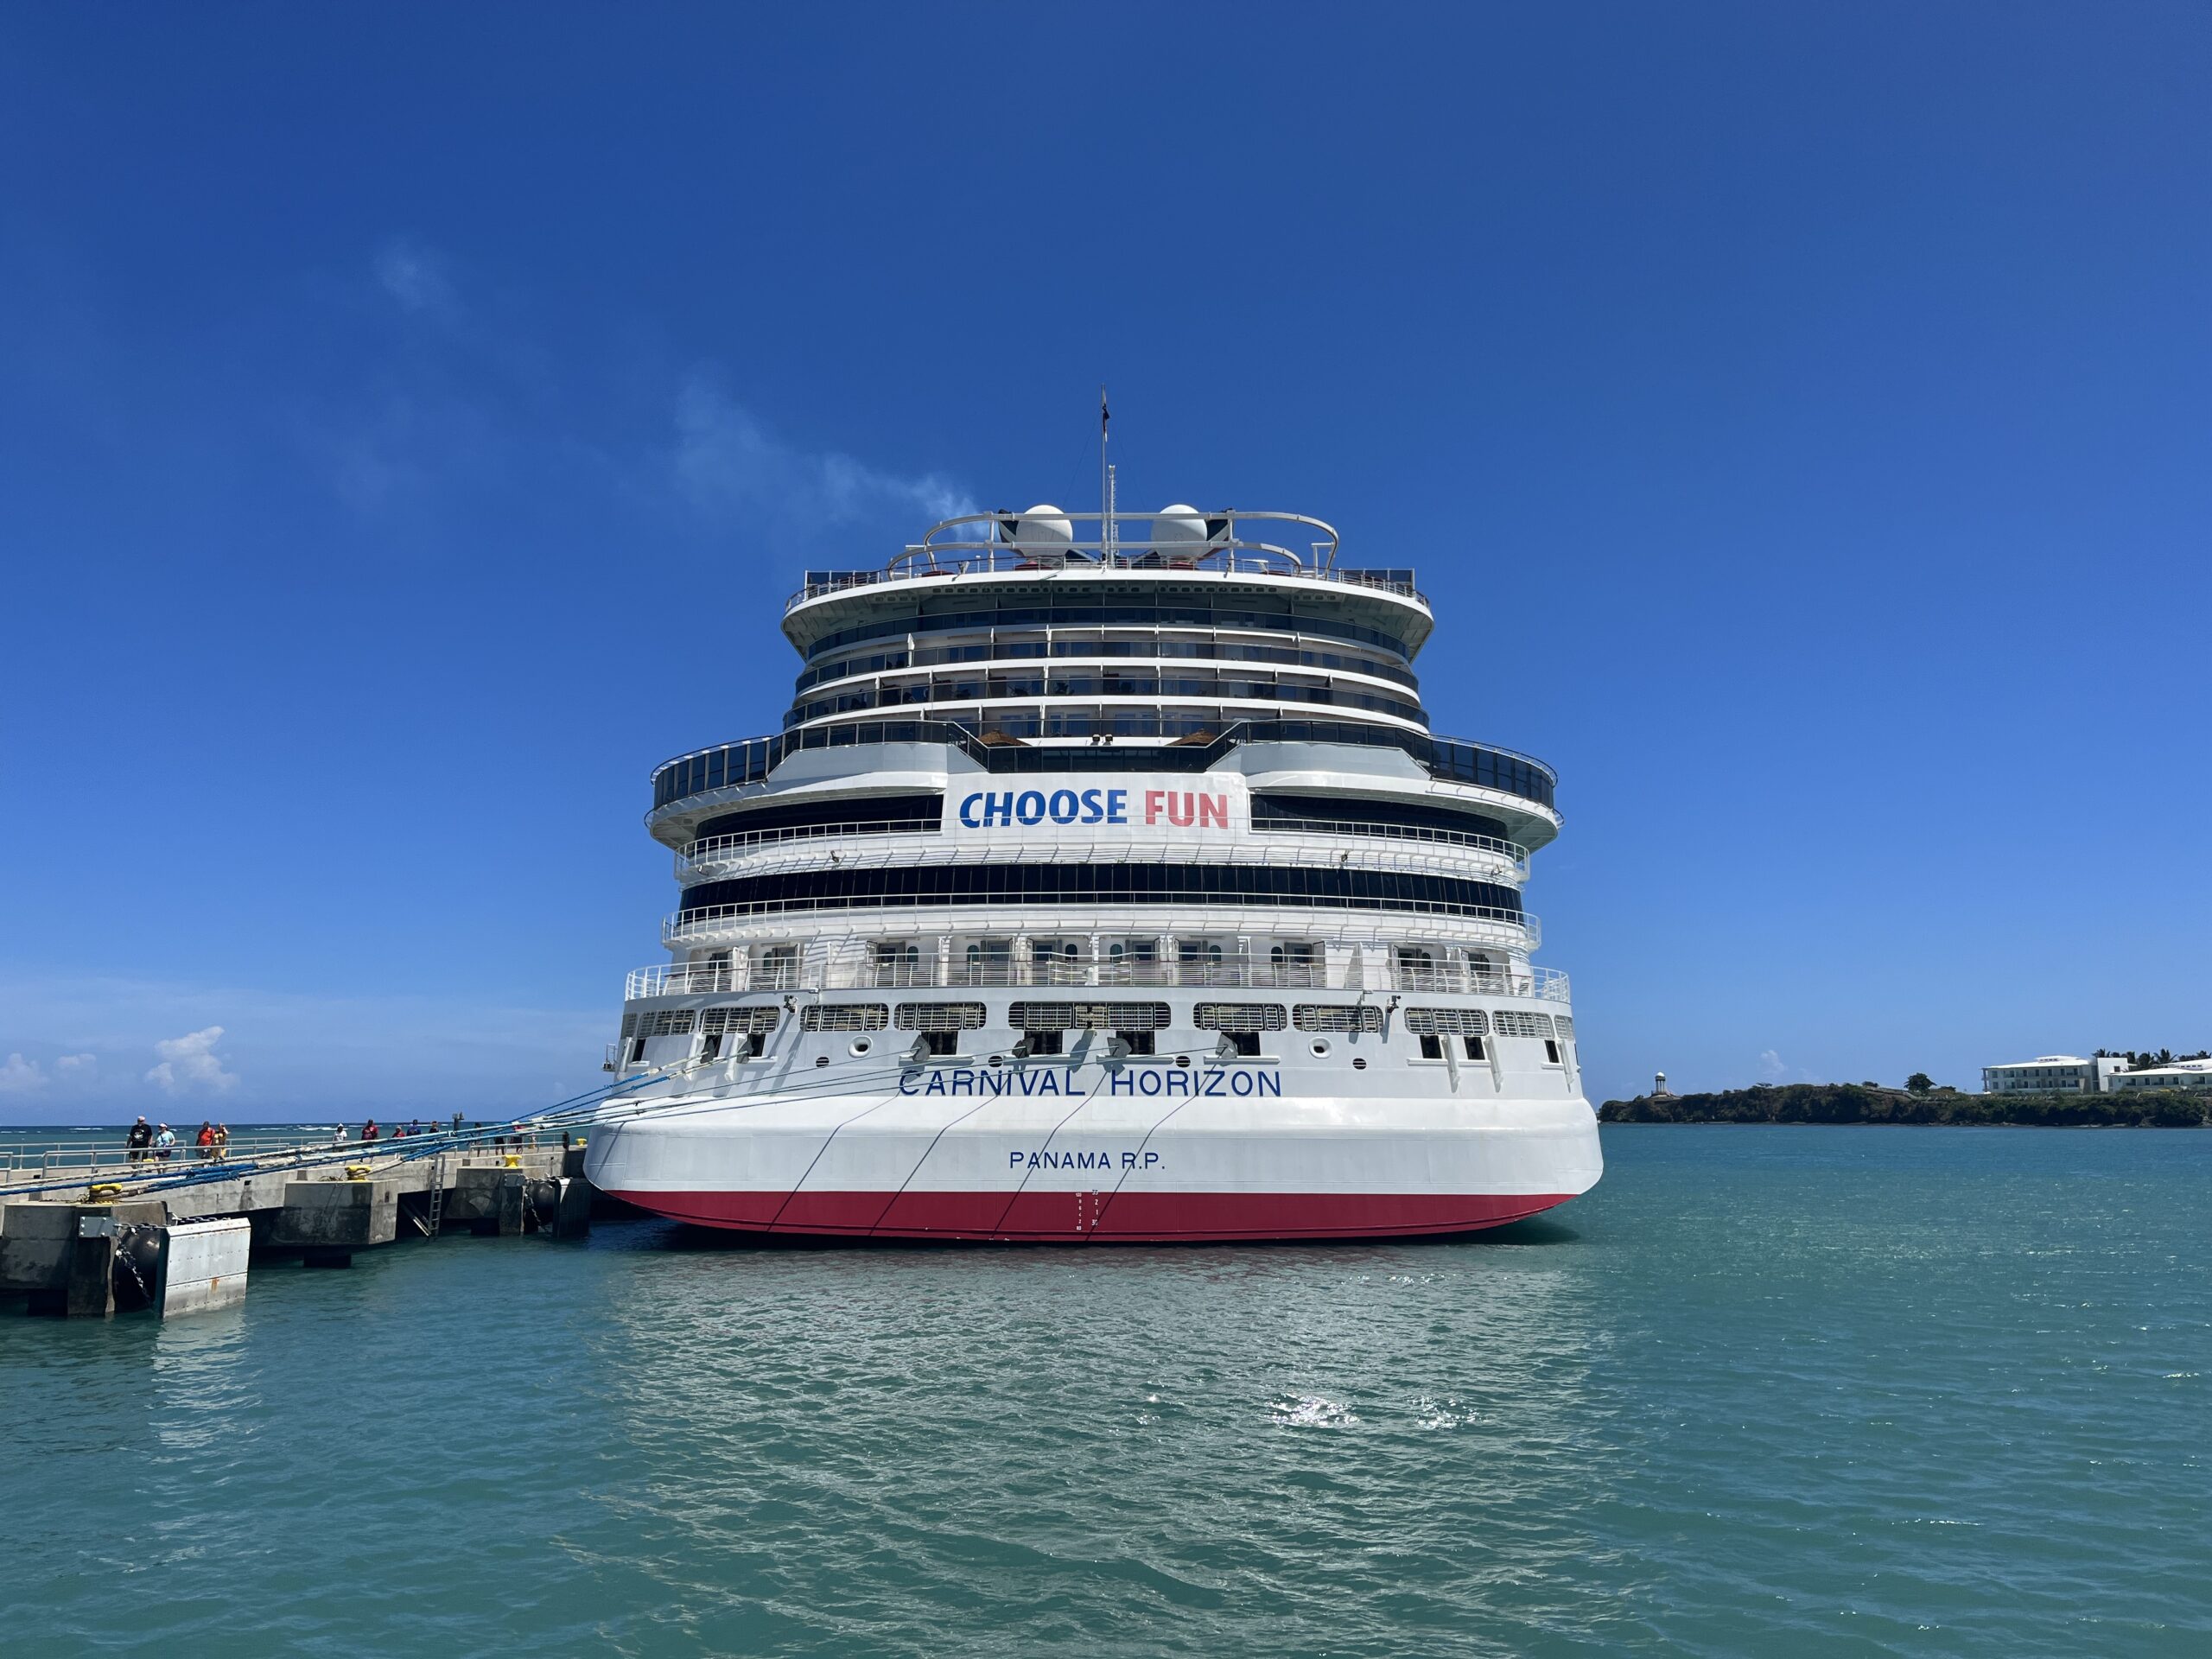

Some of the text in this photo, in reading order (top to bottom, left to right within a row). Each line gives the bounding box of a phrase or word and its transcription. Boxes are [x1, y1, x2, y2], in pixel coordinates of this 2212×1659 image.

[959, 789, 1229, 829] CHOOSE FUN
[899, 1070, 1281, 1096] CARNIVAL HORIZON
[1009, 1152, 1166, 1169] PANAMA R.P.
